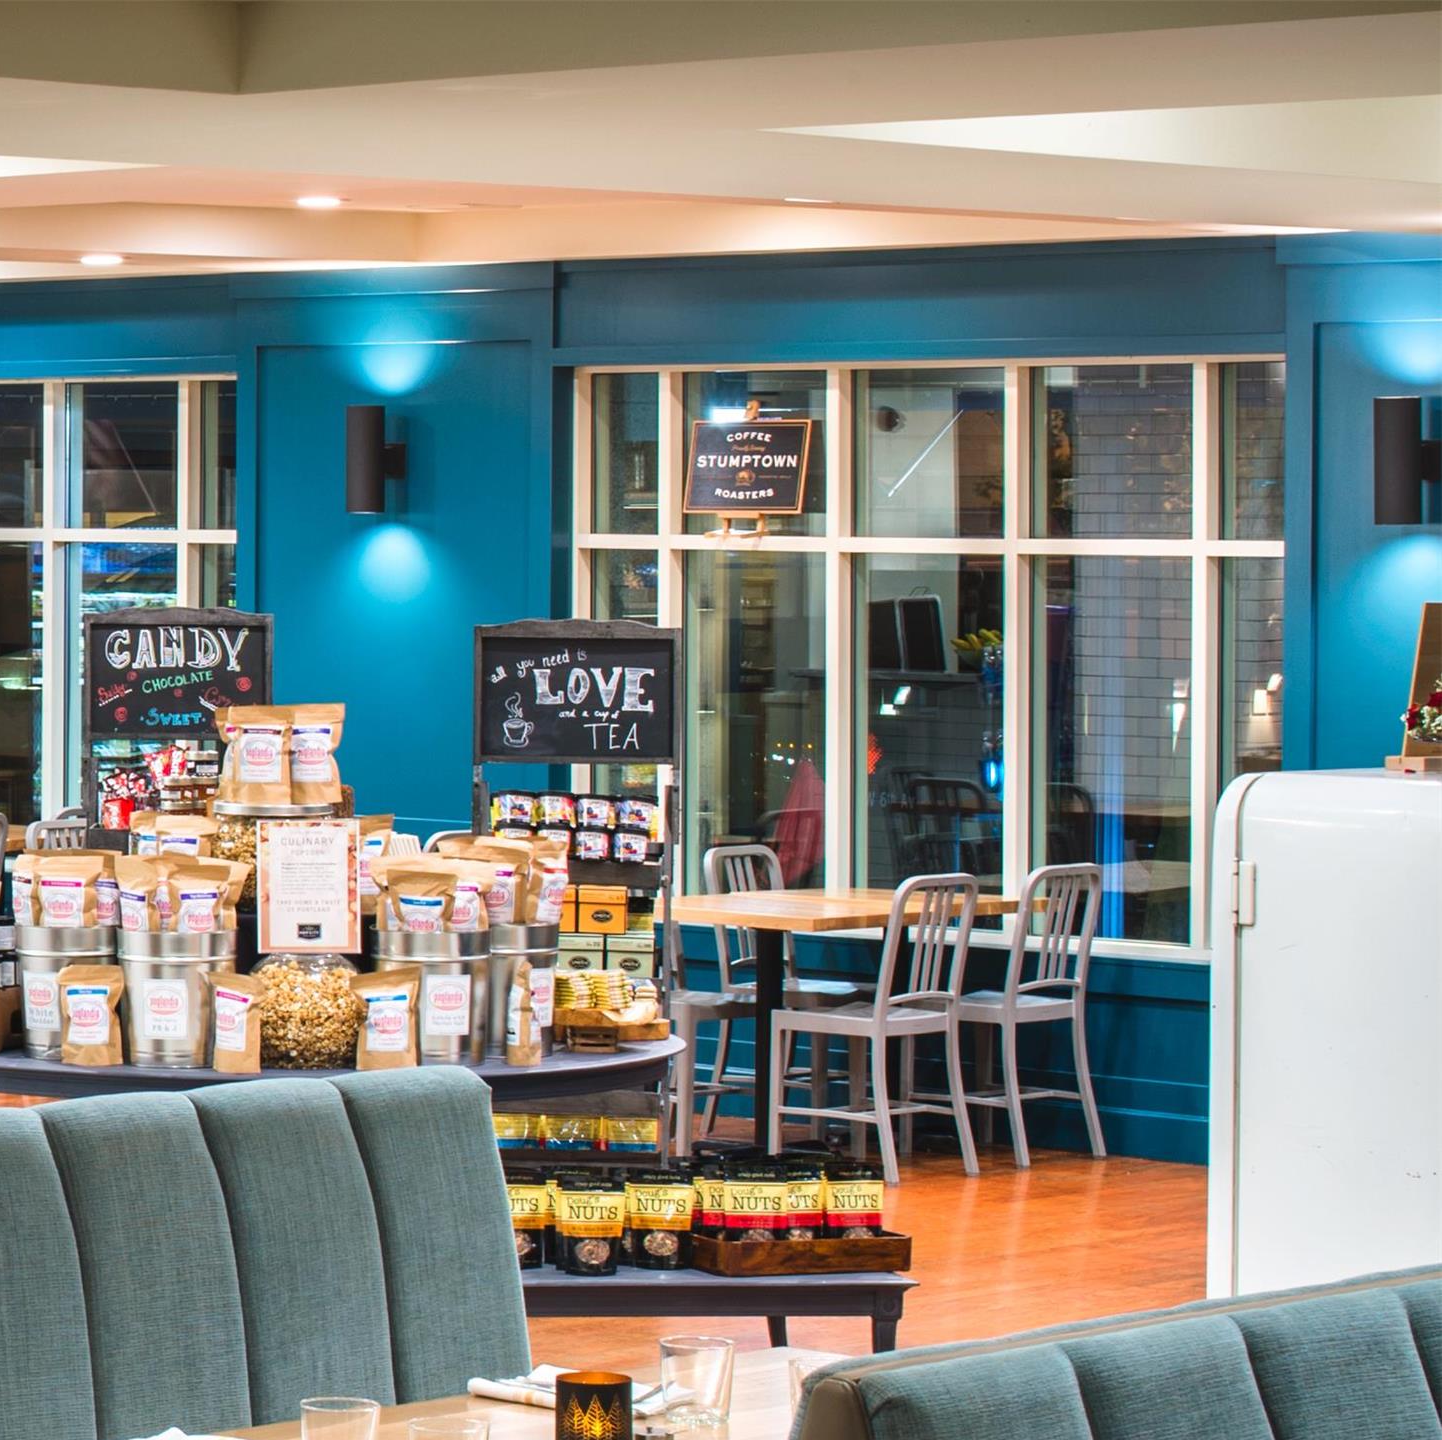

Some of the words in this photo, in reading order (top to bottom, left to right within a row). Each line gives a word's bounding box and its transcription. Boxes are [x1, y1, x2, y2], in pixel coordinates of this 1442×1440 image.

[726, 432, 772, 442] COFFEE
[696, 455, 798, 468] STUMPTOWN
[715, 488, 774, 500] ROASTERS
[105, 627, 249, 672] CANDY
[517, 658, 534, 678] you
[542, 648, 569, 668] need
[577, 648, 587, 661] is
[142, 671, 214, 693] CHOCOLATE
[533, 666, 655, 712] LOVE
[583, 722, 640, 750] TEA
[280, 838, 334, 846] CULINARY
[637, 1198, 686, 1212] NUTS
[732, 1196, 782, 1210] NUTS
[790, 1194, 819, 1208] UTS
[834, 1194, 878, 1208] NUTS
[568, 1205, 618, 1220] NUTS
